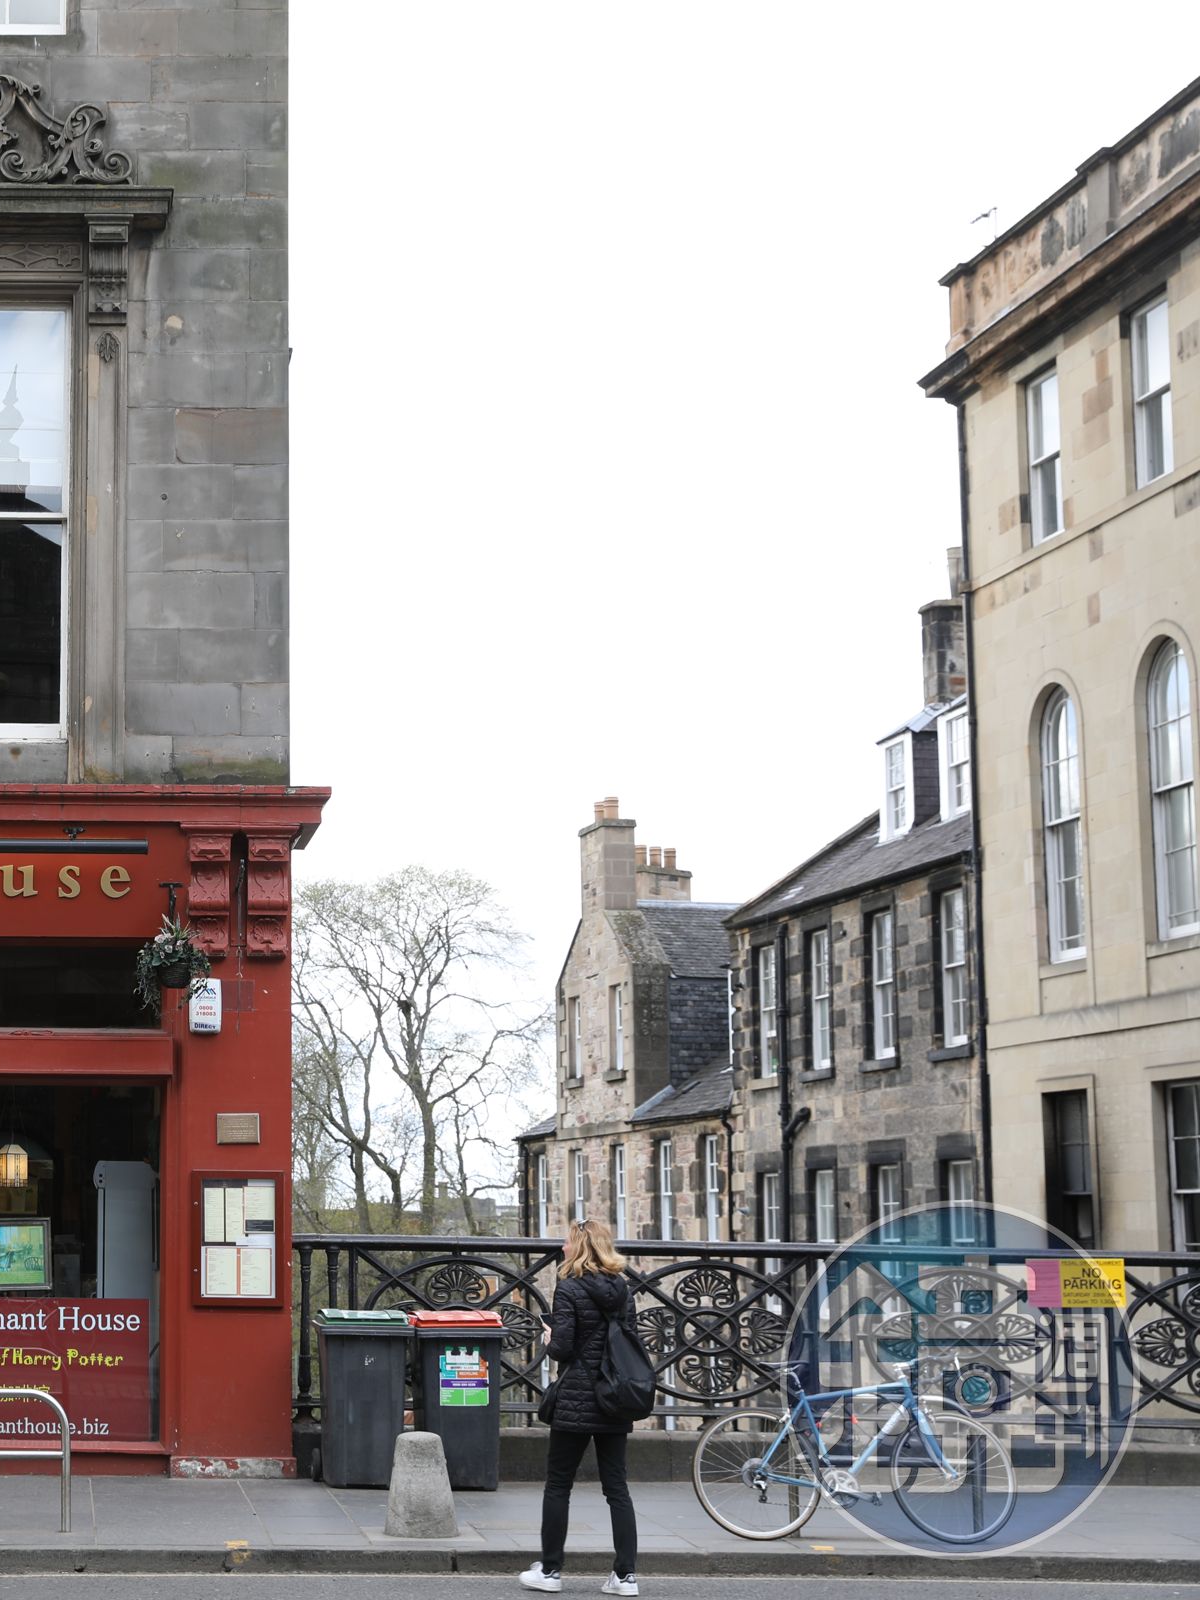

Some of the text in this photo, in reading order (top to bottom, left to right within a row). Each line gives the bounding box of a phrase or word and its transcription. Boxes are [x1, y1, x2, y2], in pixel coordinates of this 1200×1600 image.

[1081, 1267, 1102, 1278] NO
[1063, 1279, 1122, 1290] PARKING
[58, 1306, 141, 1332] House
[12, 1347, 62, 1371] Harry
[66, 1348, 124, 1367] Potter
